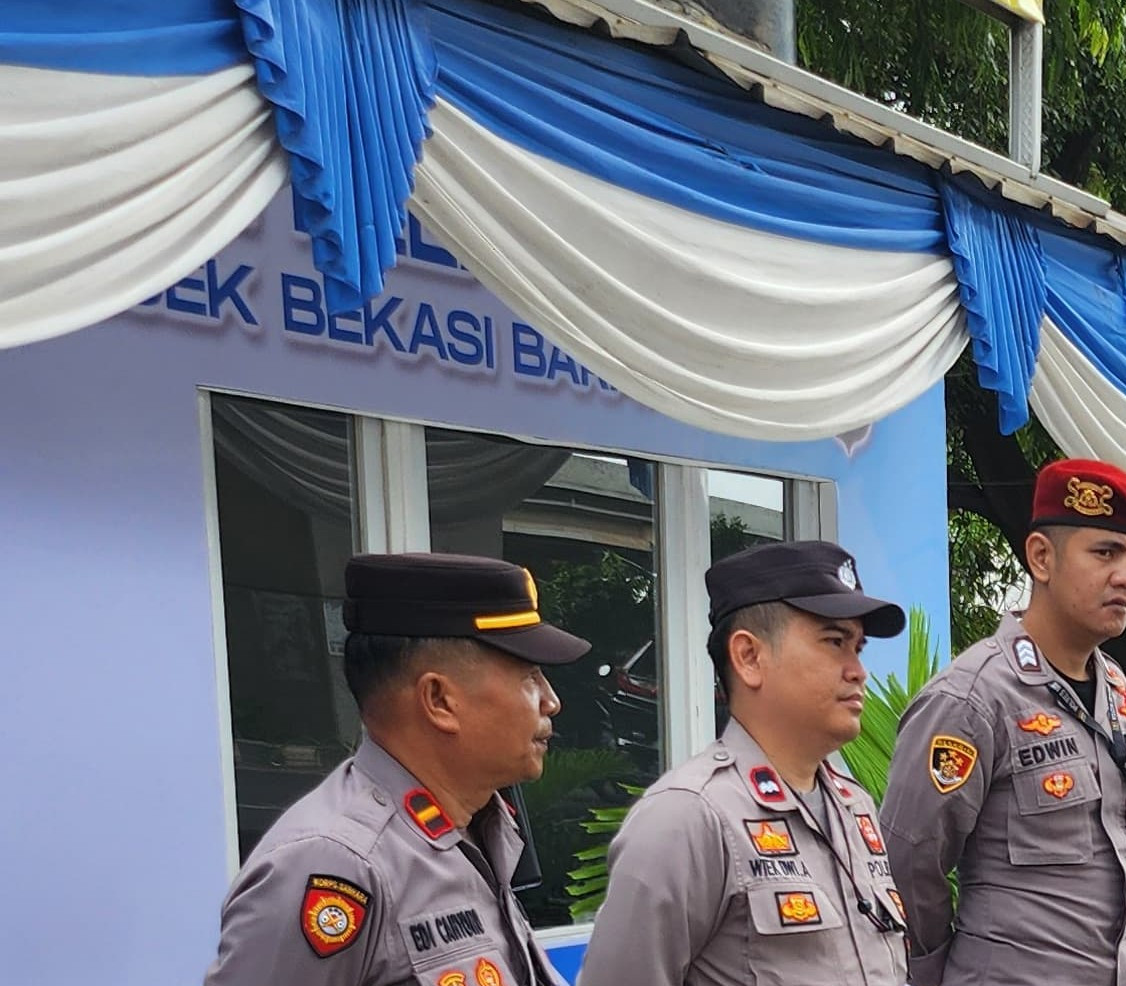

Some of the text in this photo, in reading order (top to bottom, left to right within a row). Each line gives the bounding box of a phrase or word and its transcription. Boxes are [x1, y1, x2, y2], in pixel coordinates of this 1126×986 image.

[139, 258, 258, 326] EK
[512, 322, 617, 392] BA
[1018, 737, 1080, 767] EDWIN
